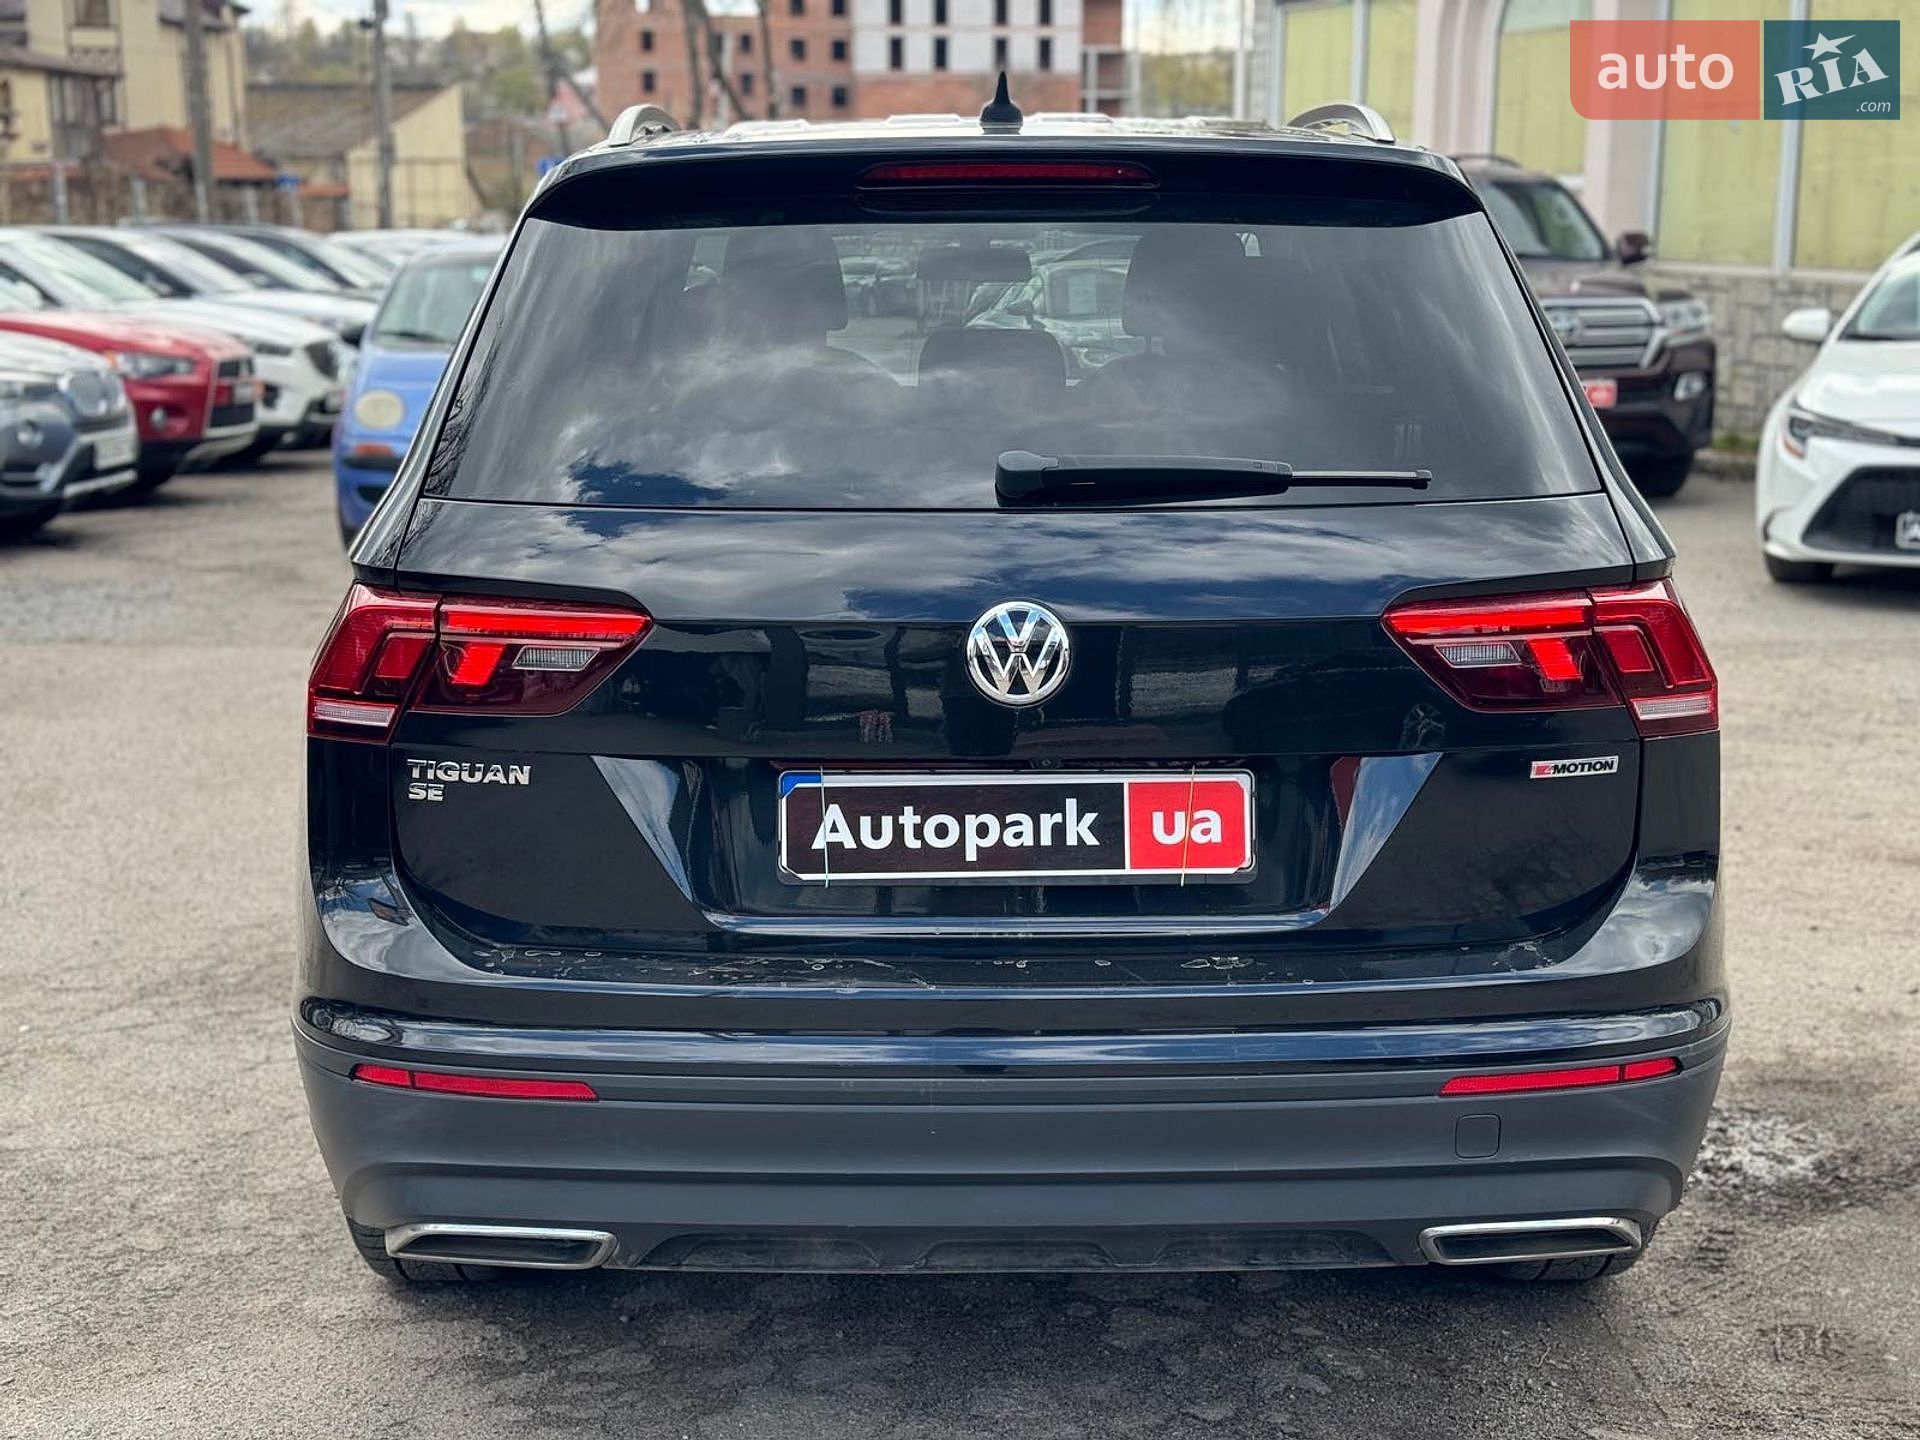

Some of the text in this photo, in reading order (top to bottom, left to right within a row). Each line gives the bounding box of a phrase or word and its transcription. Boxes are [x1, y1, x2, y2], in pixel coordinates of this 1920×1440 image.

[407, 758, 532, 785] TIGUAN
[408, 782, 445, 801] SE
[811, 798, 1222, 862] Autopark ua
